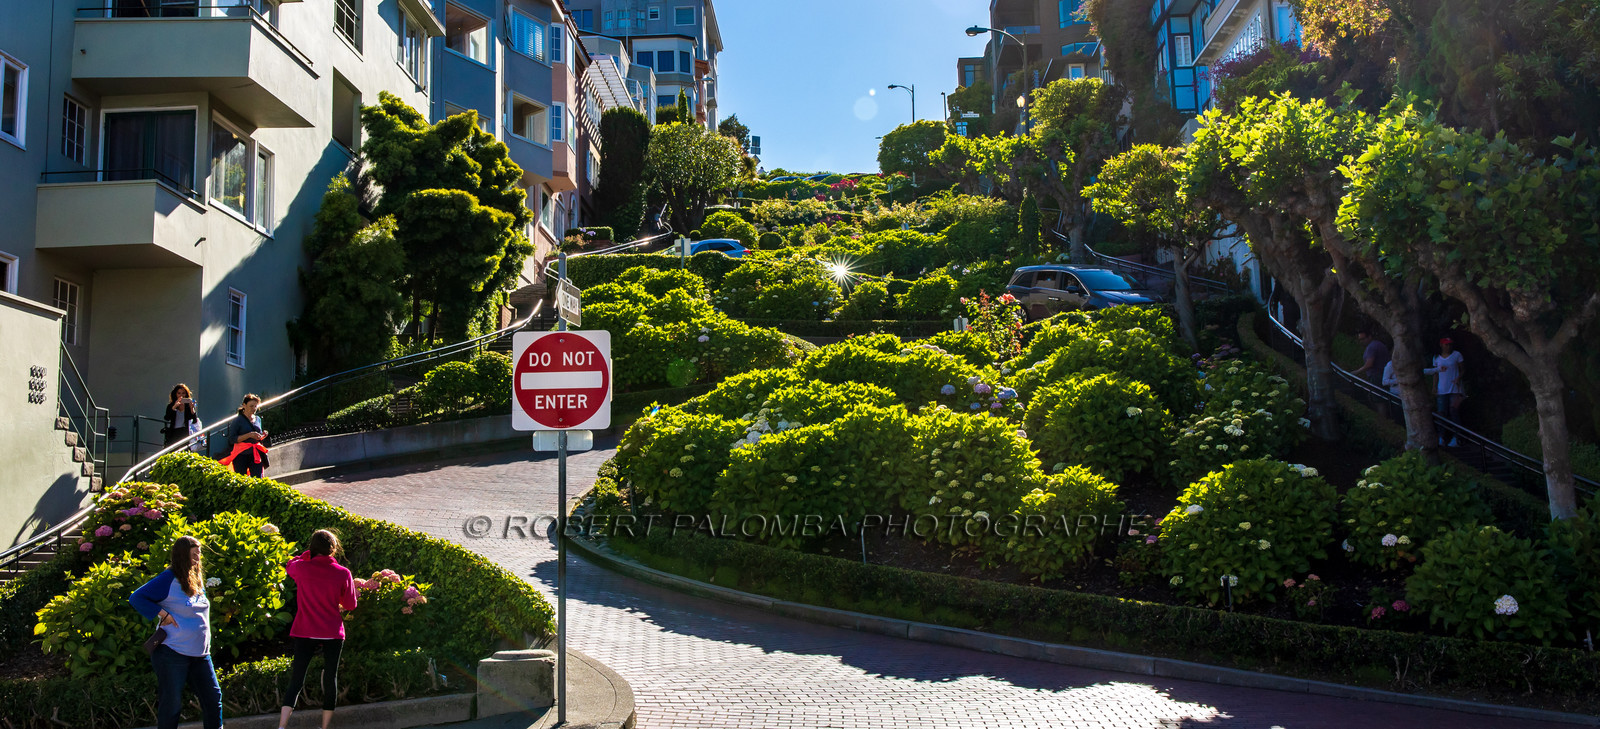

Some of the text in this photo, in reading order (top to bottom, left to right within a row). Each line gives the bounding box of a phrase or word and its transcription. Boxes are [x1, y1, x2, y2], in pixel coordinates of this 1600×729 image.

[529, 351, 595, 367] DO NOT
[535, 394, 588, 410] ENTER
